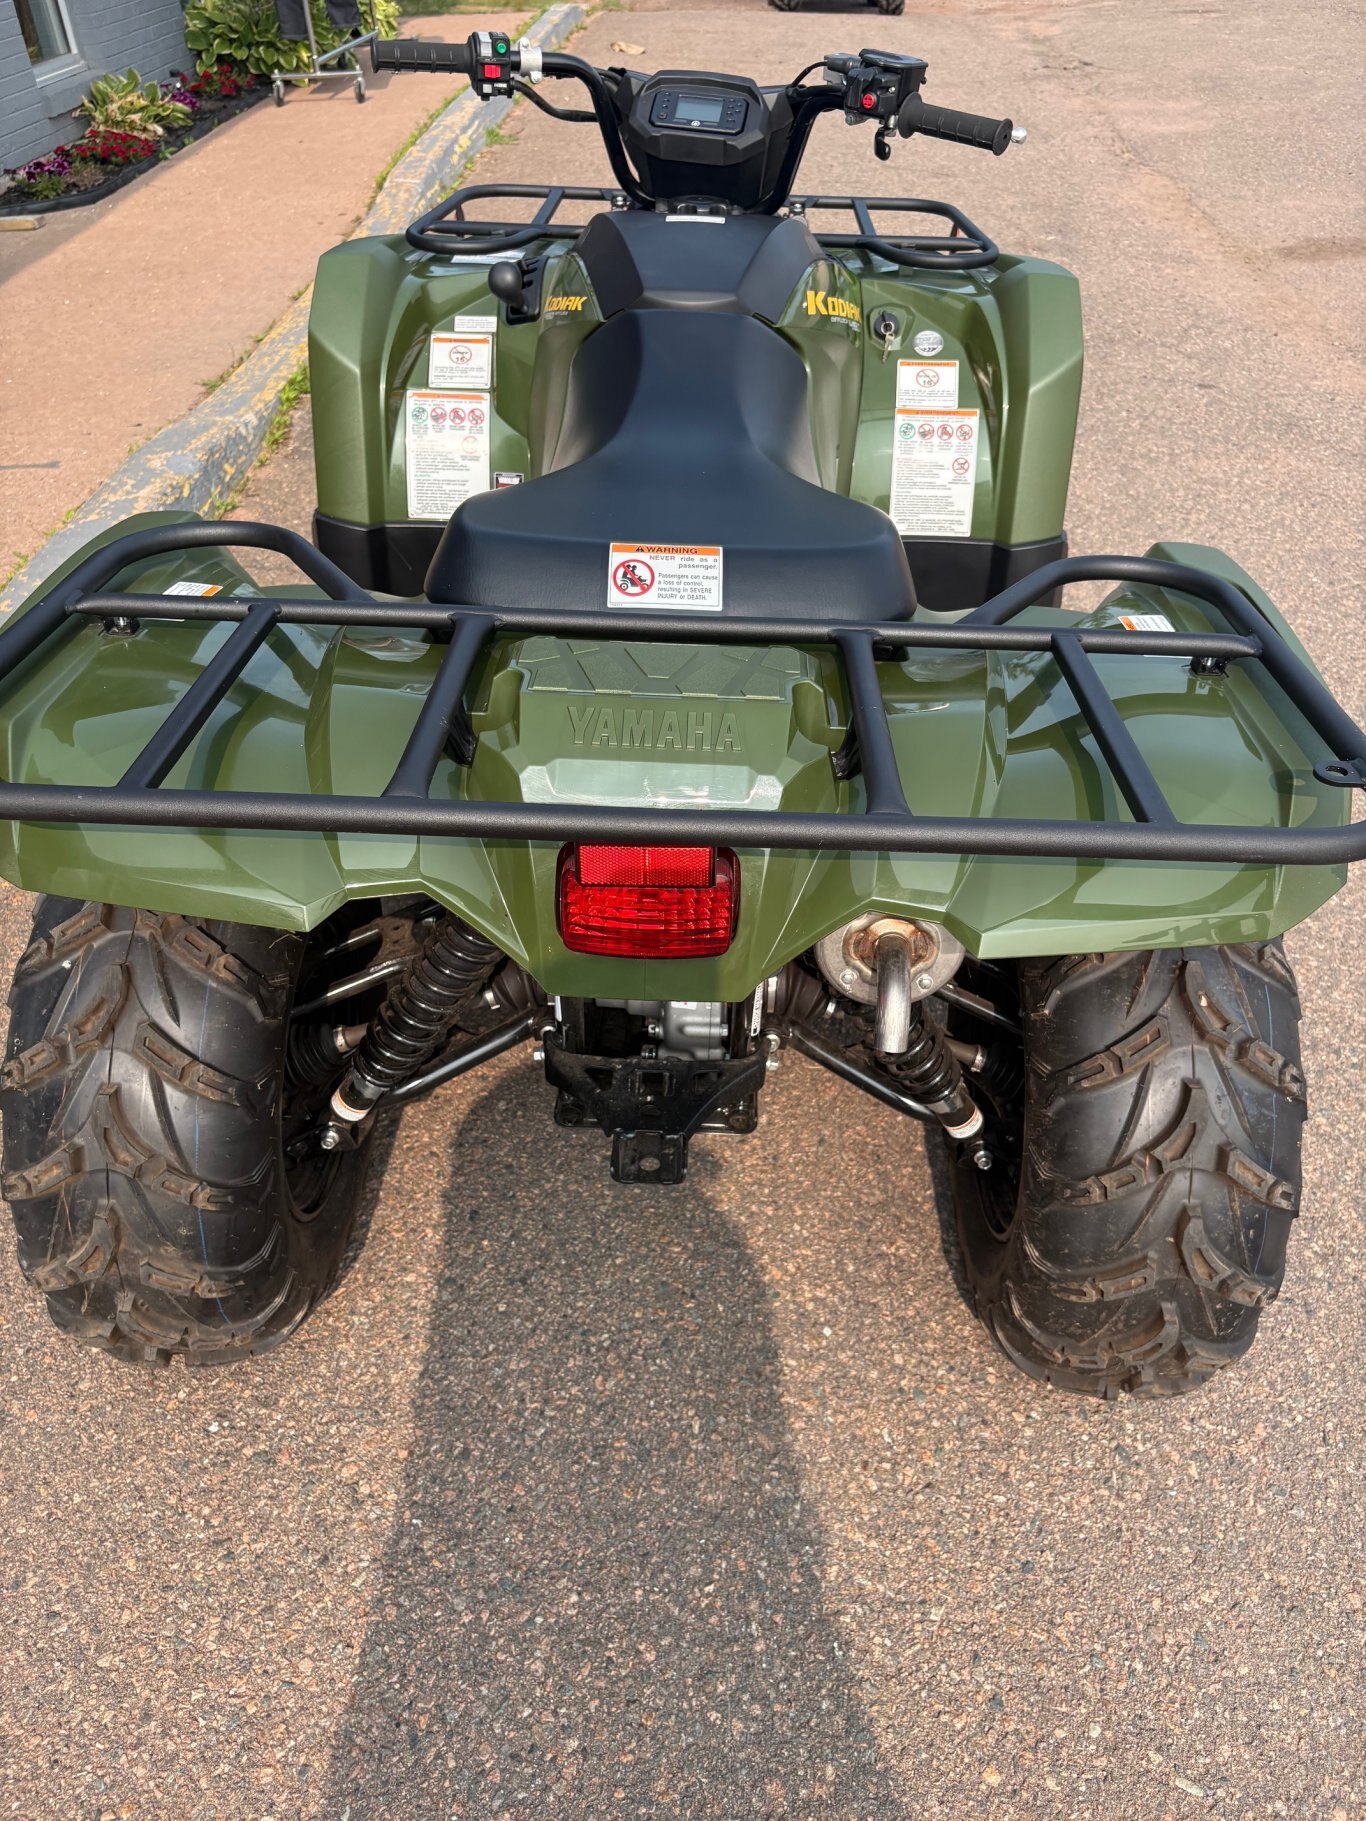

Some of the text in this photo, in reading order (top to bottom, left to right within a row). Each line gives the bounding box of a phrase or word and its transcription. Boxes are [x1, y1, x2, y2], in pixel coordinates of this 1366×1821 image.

[646, 546, 698, 555] WARNING
[678, 563, 718, 571] passenger.
[658, 572, 689, 580] Passengers
[657, 586, 681, 594] resulting
[567, 706, 742, 752] YAMAHA
